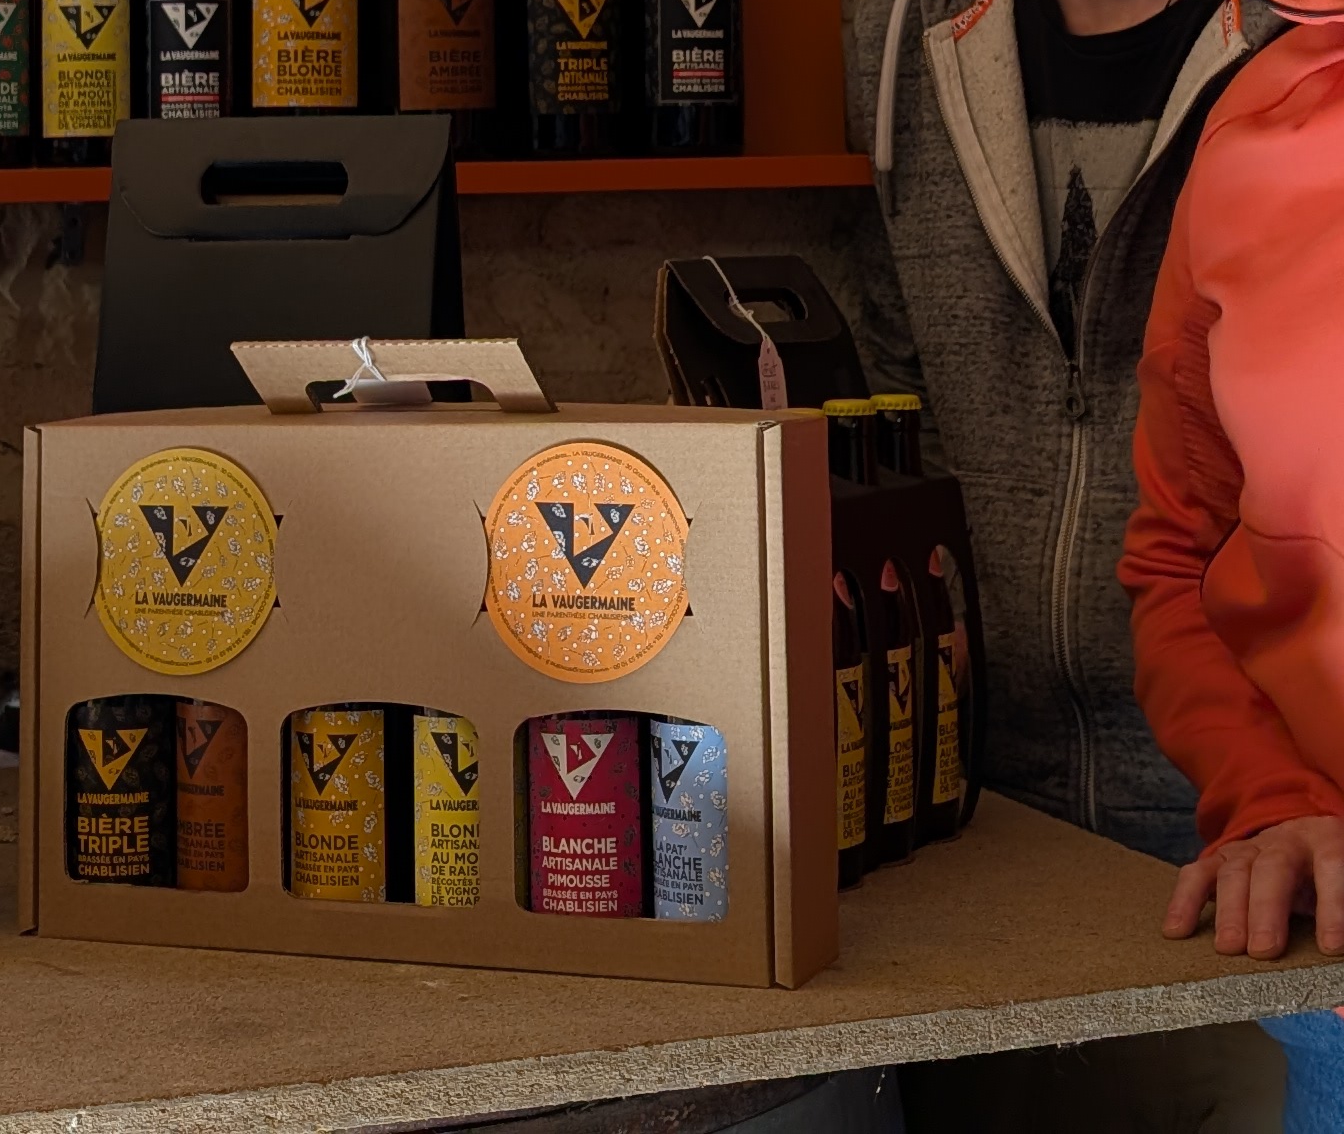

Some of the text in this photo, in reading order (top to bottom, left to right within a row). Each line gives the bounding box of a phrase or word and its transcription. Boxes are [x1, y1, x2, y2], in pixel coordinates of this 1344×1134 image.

[277, 46, 342, 63] BIÈRE
[672, 47, 724, 63] BIÈRE
[277, 65, 342, 77] BLONDE
[557, 58, 608, 71] TRIPLE
[58, 69, 111, 82] BLONDE
[161, 69, 219, 87] BIÈRE
[135, 591, 227, 608] LA VAUGERMAINE
[532, 594, 635, 611] LA VAUGERMAINE
[148, 608, 183, 616] PARENTHÈSE
[546, 611, 587, 619] PARENTHÈSE
[78, 792, 149, 805] LA VAUGERMAINE
[296, 798, 358, 811] LA VAUGERMAINE
[541, 801, 616, 815] LA VAUGERMAINE
[78, 813, 149, 834] BIÈRE
[78, 834, 149, 853] TRIPLE
[295, 833, 358, 850] BLONDE
[542, 836, 617, 854] BLANCHE
[665, 844, 687, 856] PAT'
[78, 854, 149, 864] BRASSÉE EN PAYS
[296, 851, 359, 863] ARTISANALE
[431, 851, 449, 864] AU
[78, 864, 149, 877] CHABLISIEN
[542, 857, 618, 871] ARTISANALE
[431, 866, 446, 876] DE
[296, 872, 359, 886] CHABLISIEN
[431, 876, 471, 887] RÉCOLTÉS
[548, 875, 610, 888] PIMOUSSE
[432, 886, 443, 896] LE
[543, 889, 618, 900] BRASSÉE EN PAYS
[431, 896, 445, 906] DE
[543, 900, 618, 912] CHABLISIEN
